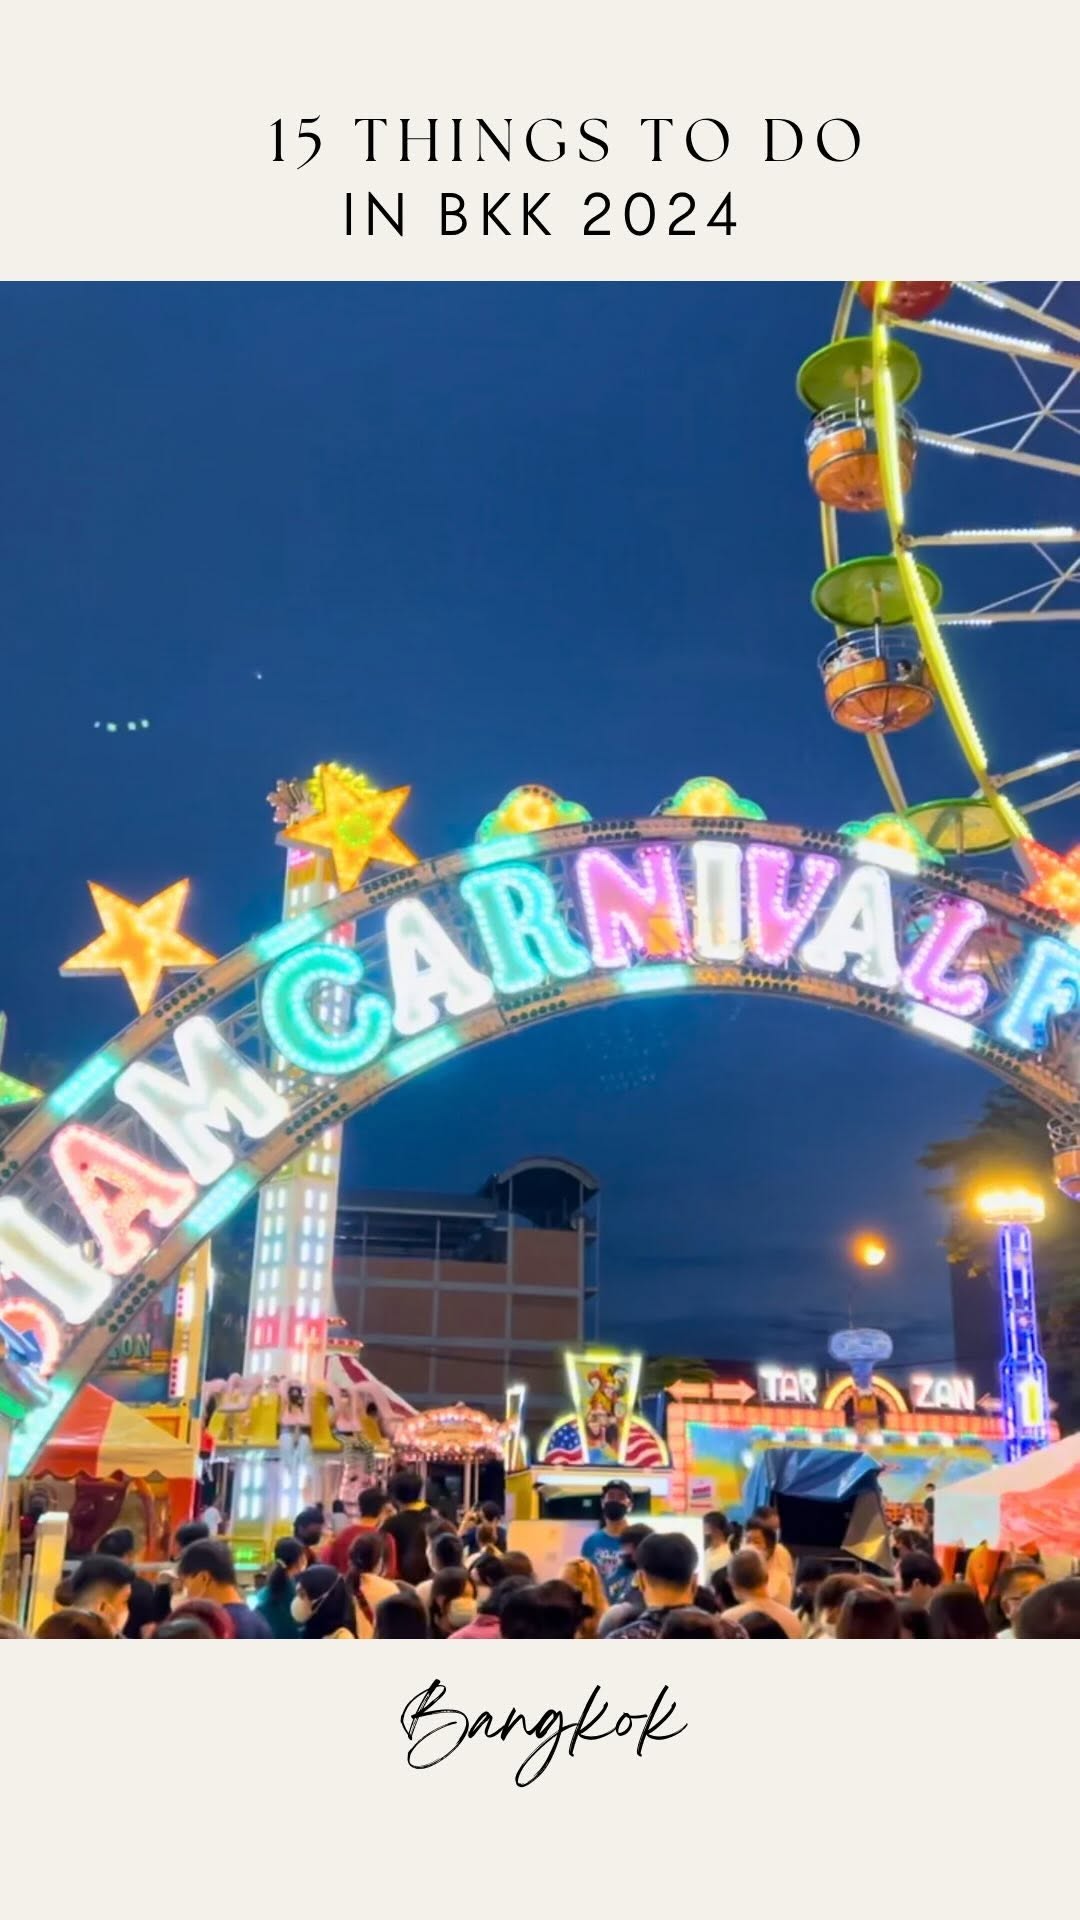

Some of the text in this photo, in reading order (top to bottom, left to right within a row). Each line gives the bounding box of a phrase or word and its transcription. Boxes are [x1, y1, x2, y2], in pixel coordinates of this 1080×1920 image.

[262, 840, 989, 1075] CARNIVAL
[758, 1365, 818, 1405] TAR
[909, 1373, 978, 1411] ZAN
